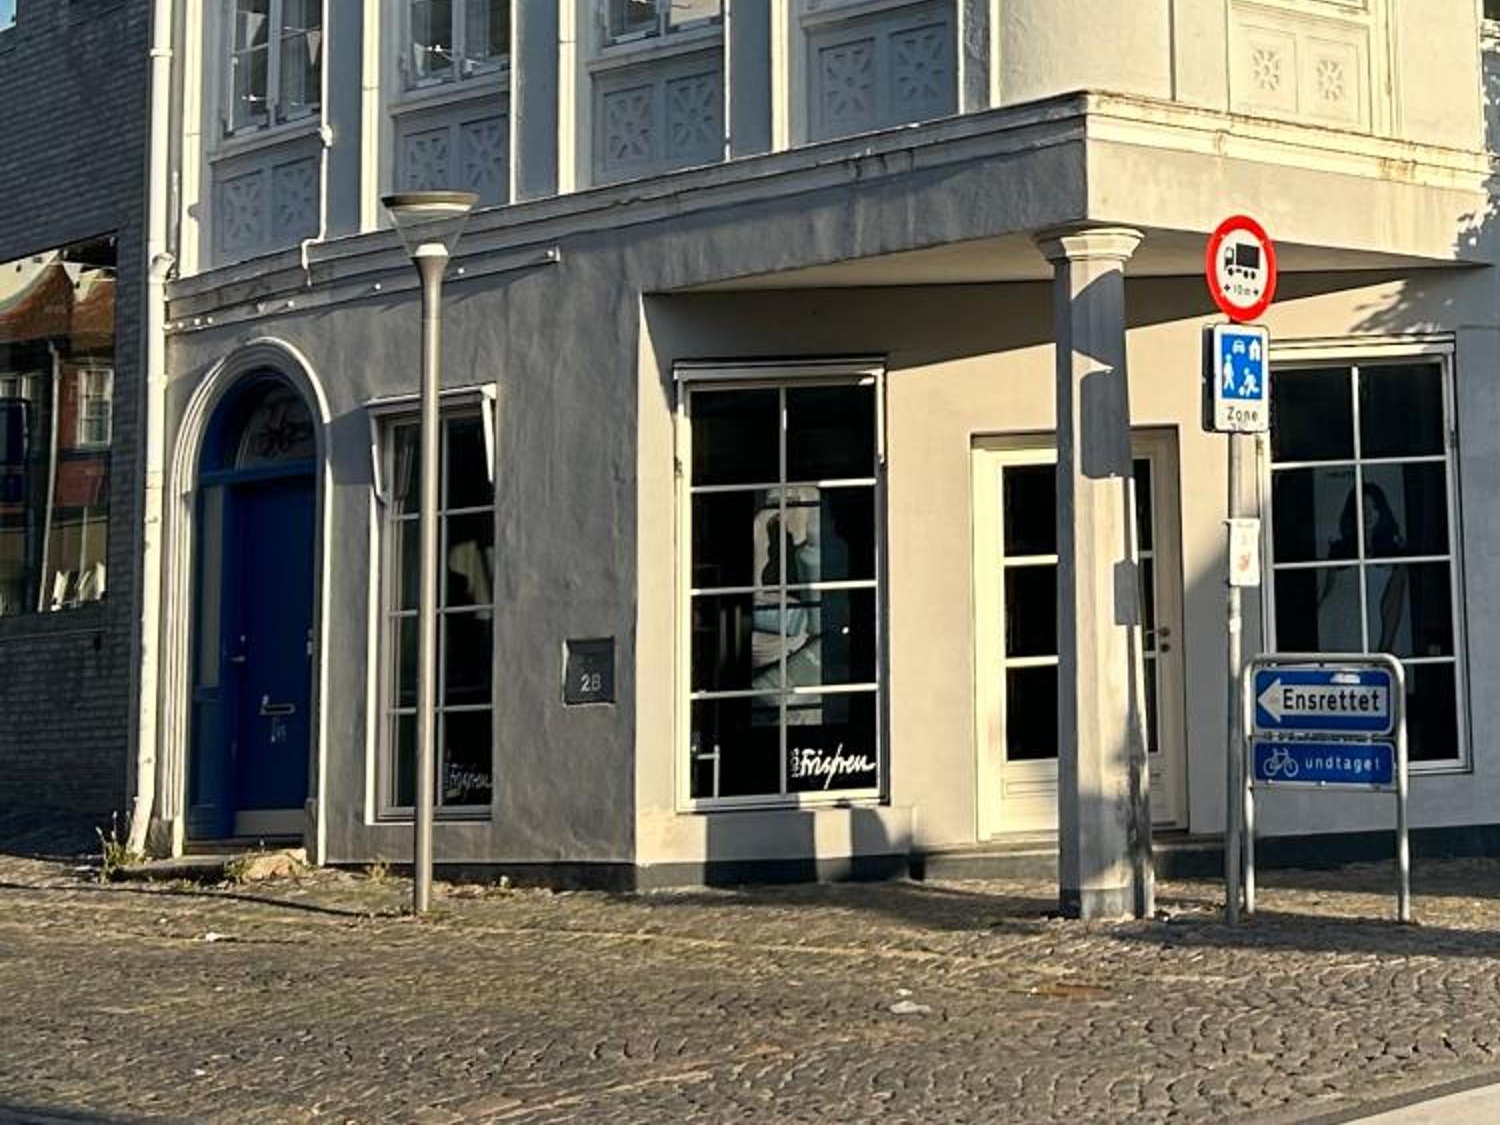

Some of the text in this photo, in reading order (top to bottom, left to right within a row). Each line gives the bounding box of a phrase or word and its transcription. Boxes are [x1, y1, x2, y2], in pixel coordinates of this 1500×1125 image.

[1227, 406, 1258, 422] Zone
[1282, 688, 1380, 711] Ensrettet
[1305, 755, 1380, 774] undtaget
